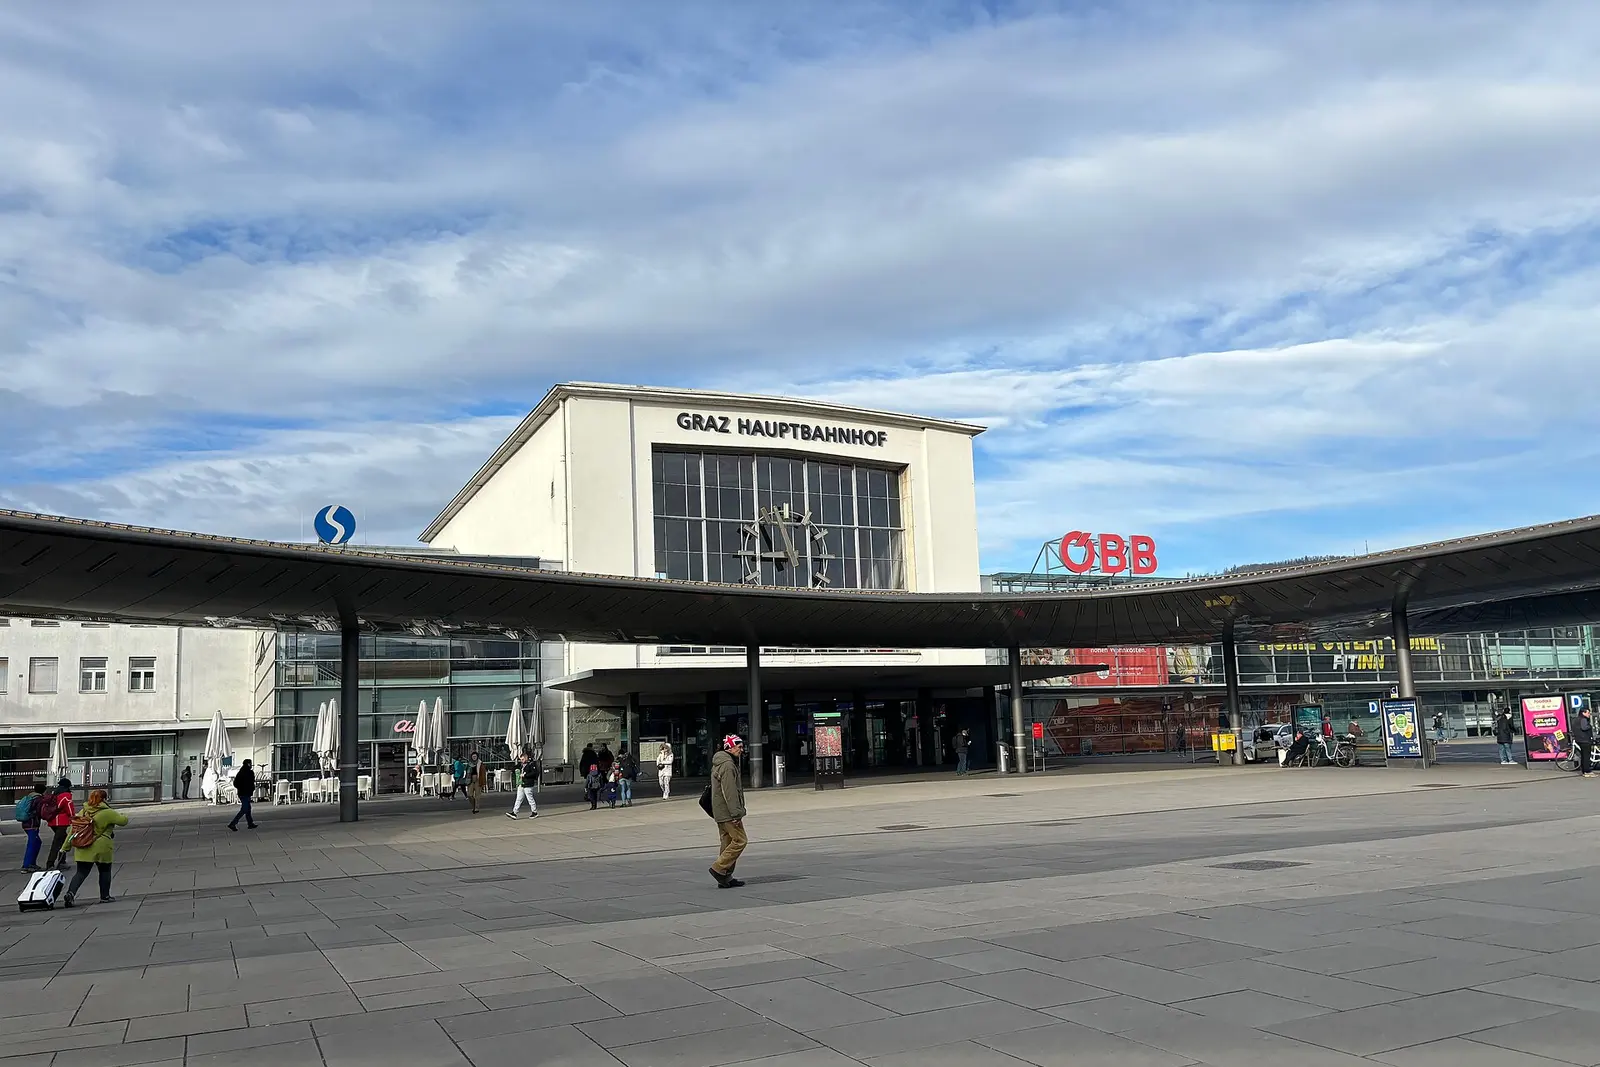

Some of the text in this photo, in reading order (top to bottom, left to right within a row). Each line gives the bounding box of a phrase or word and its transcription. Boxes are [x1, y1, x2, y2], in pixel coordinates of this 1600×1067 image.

[677, 412, 888, 447] GRAZ HAUPTBAHNHOF
[1369, 701, 1377, 713] D
[1571, 695, 1582, 708] D
